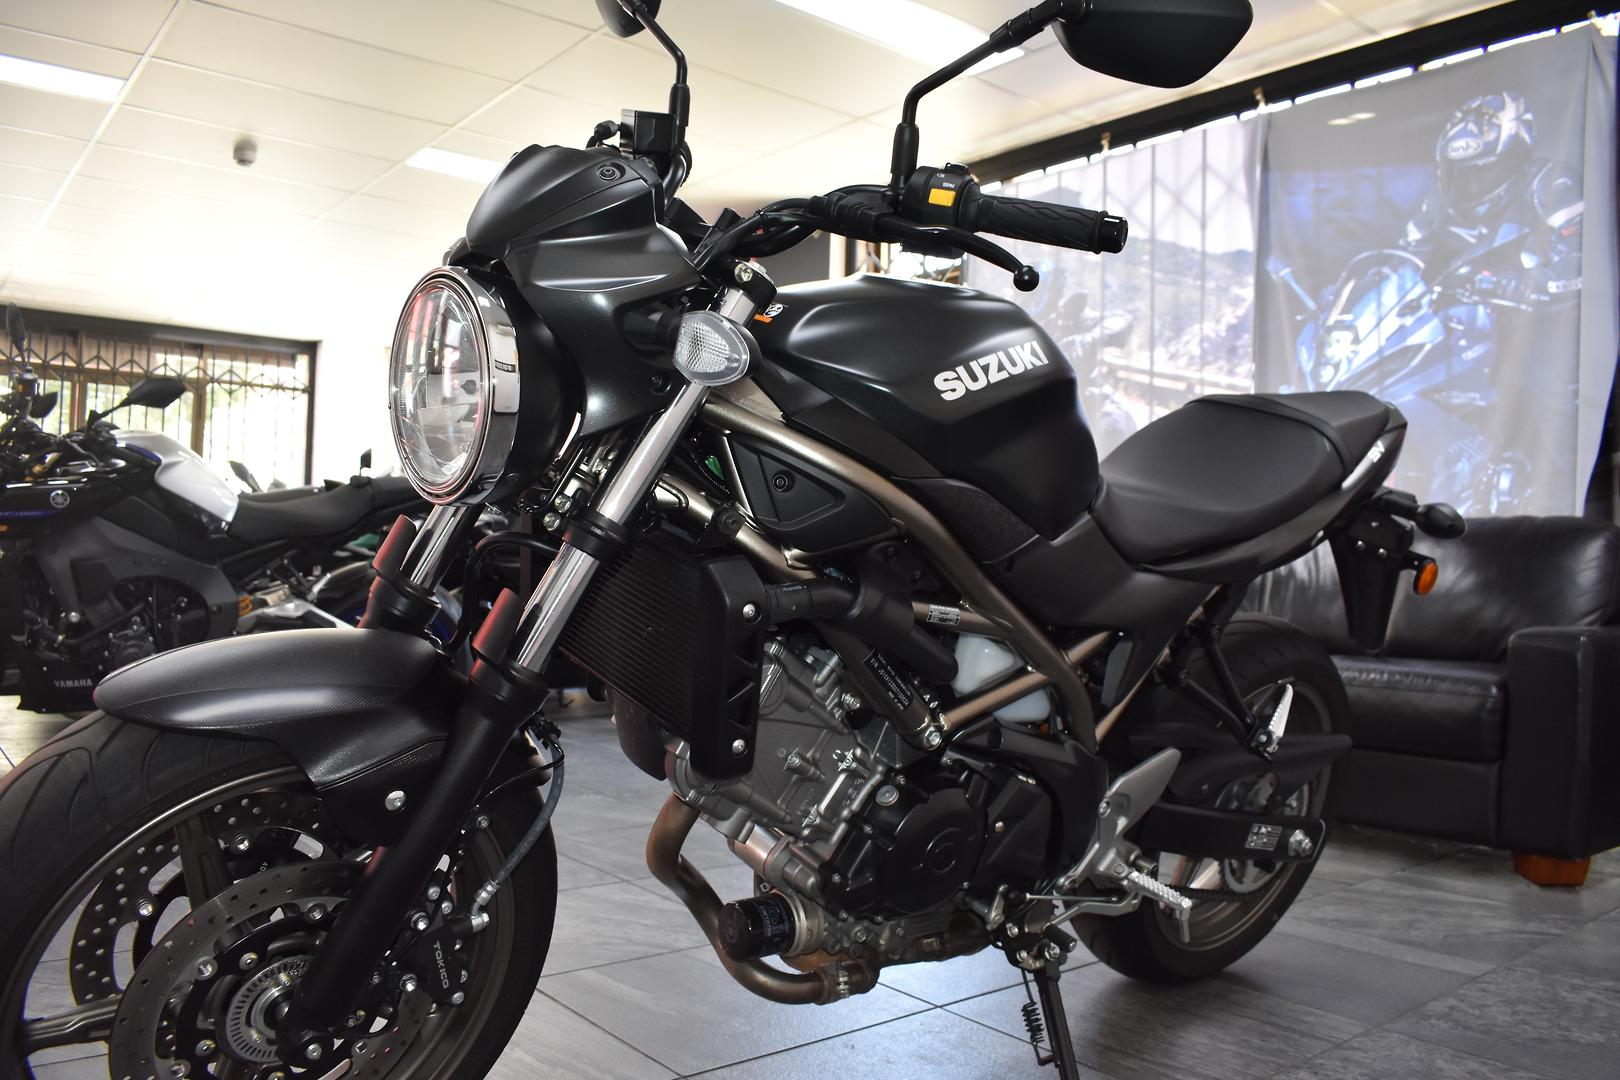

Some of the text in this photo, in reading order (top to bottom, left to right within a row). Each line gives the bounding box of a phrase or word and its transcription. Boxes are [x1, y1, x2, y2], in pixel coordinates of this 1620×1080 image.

[934, 340, 1049, 401] SUZUKI
[1367, 440, 1385, 463] SV
[54, 678, 93, 688] YAMAHA
[434, 940, 449, 989] TOKICO
